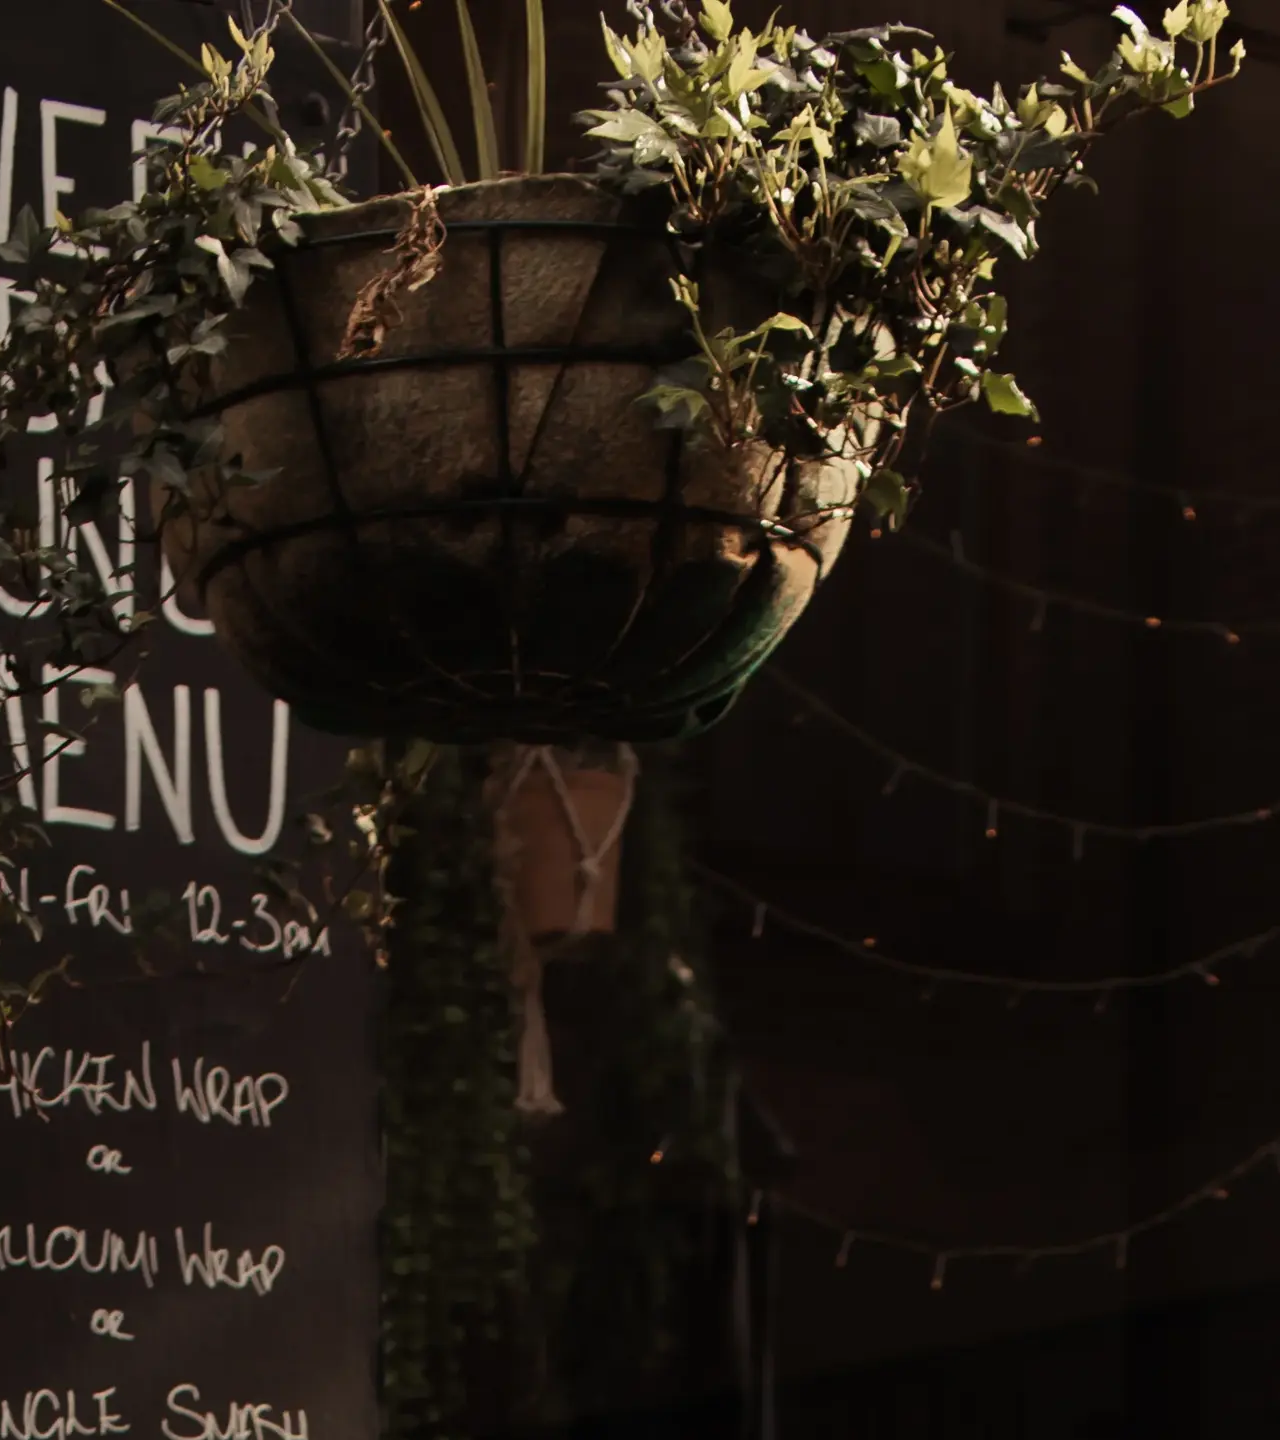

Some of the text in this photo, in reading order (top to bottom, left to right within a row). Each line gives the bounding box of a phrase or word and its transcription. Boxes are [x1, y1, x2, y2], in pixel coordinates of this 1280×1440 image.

[172, 1055, 288, 1127] WRAP
[86, 1145, 132, 1174] OR
[175, 1221, 285, 1296] WRAP
[90, 1308, 135, 1341] OR
